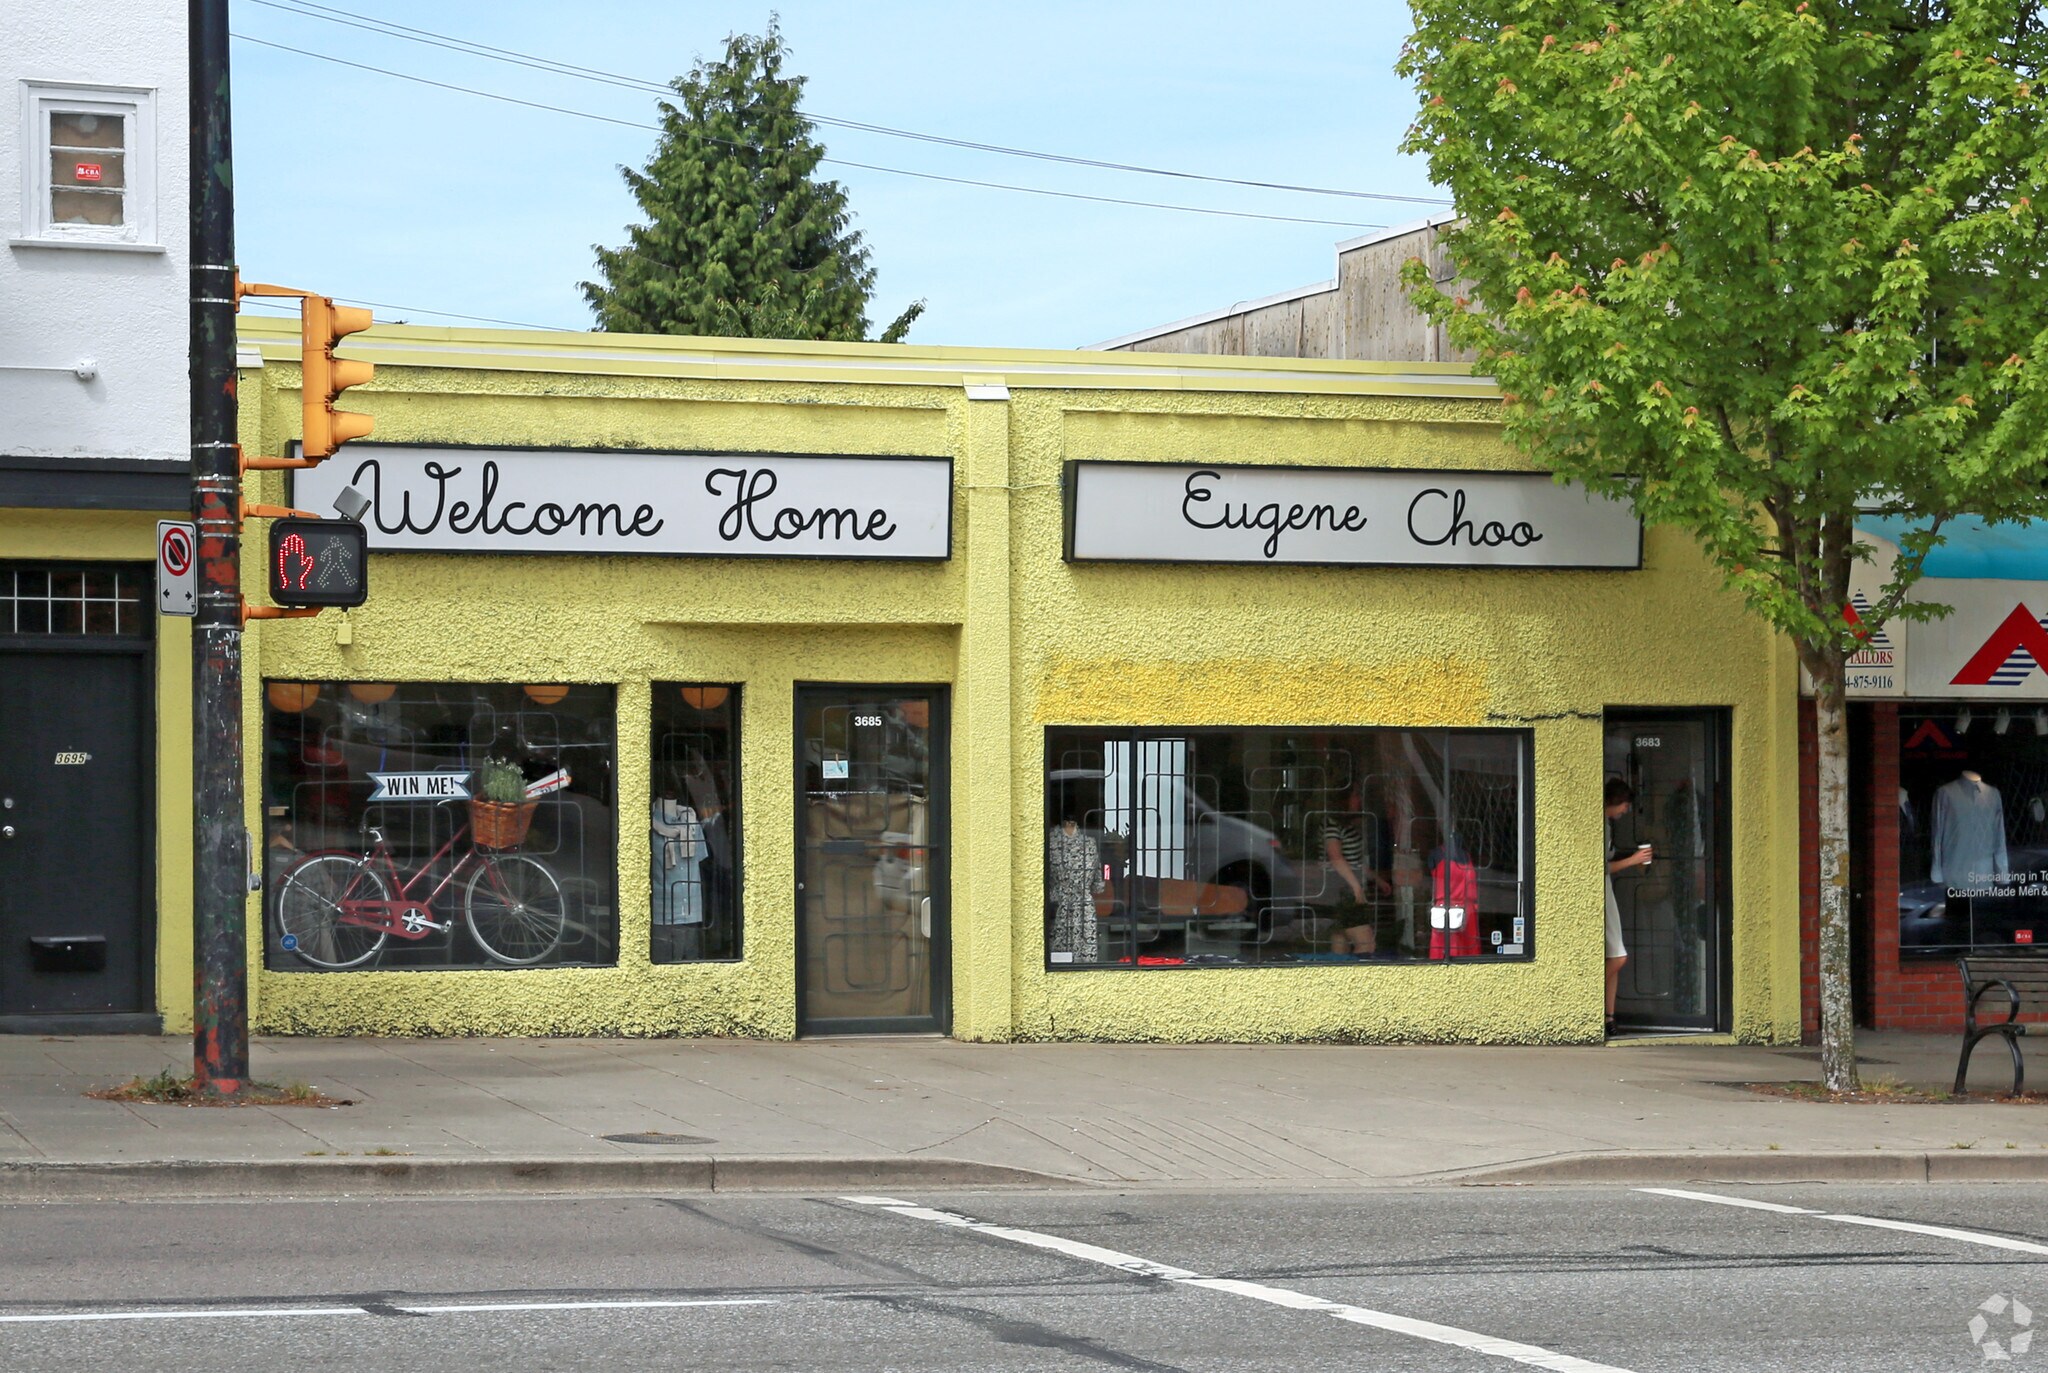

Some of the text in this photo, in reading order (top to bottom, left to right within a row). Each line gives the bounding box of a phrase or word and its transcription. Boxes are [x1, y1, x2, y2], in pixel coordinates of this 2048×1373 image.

[352, 459, 897, 542] Welcome Home
[1182, 470, 1544, 558] Eugene Choo
[1844, 675, 1893, 689] 4-875-9116
[854, 716, 882, 727] 3685
[1635, 737, 1661, 747] 3683
[56, 753, 85, 764] 3695
[387, 776, 454, 796] WIN ME!
[1968, 870, 2026, 884] Specializing
[2028, 870, 2038, 882] in
[1947, 886, 2016, 898] Custom-Made
[2018, 886, 2040, 897] Men
